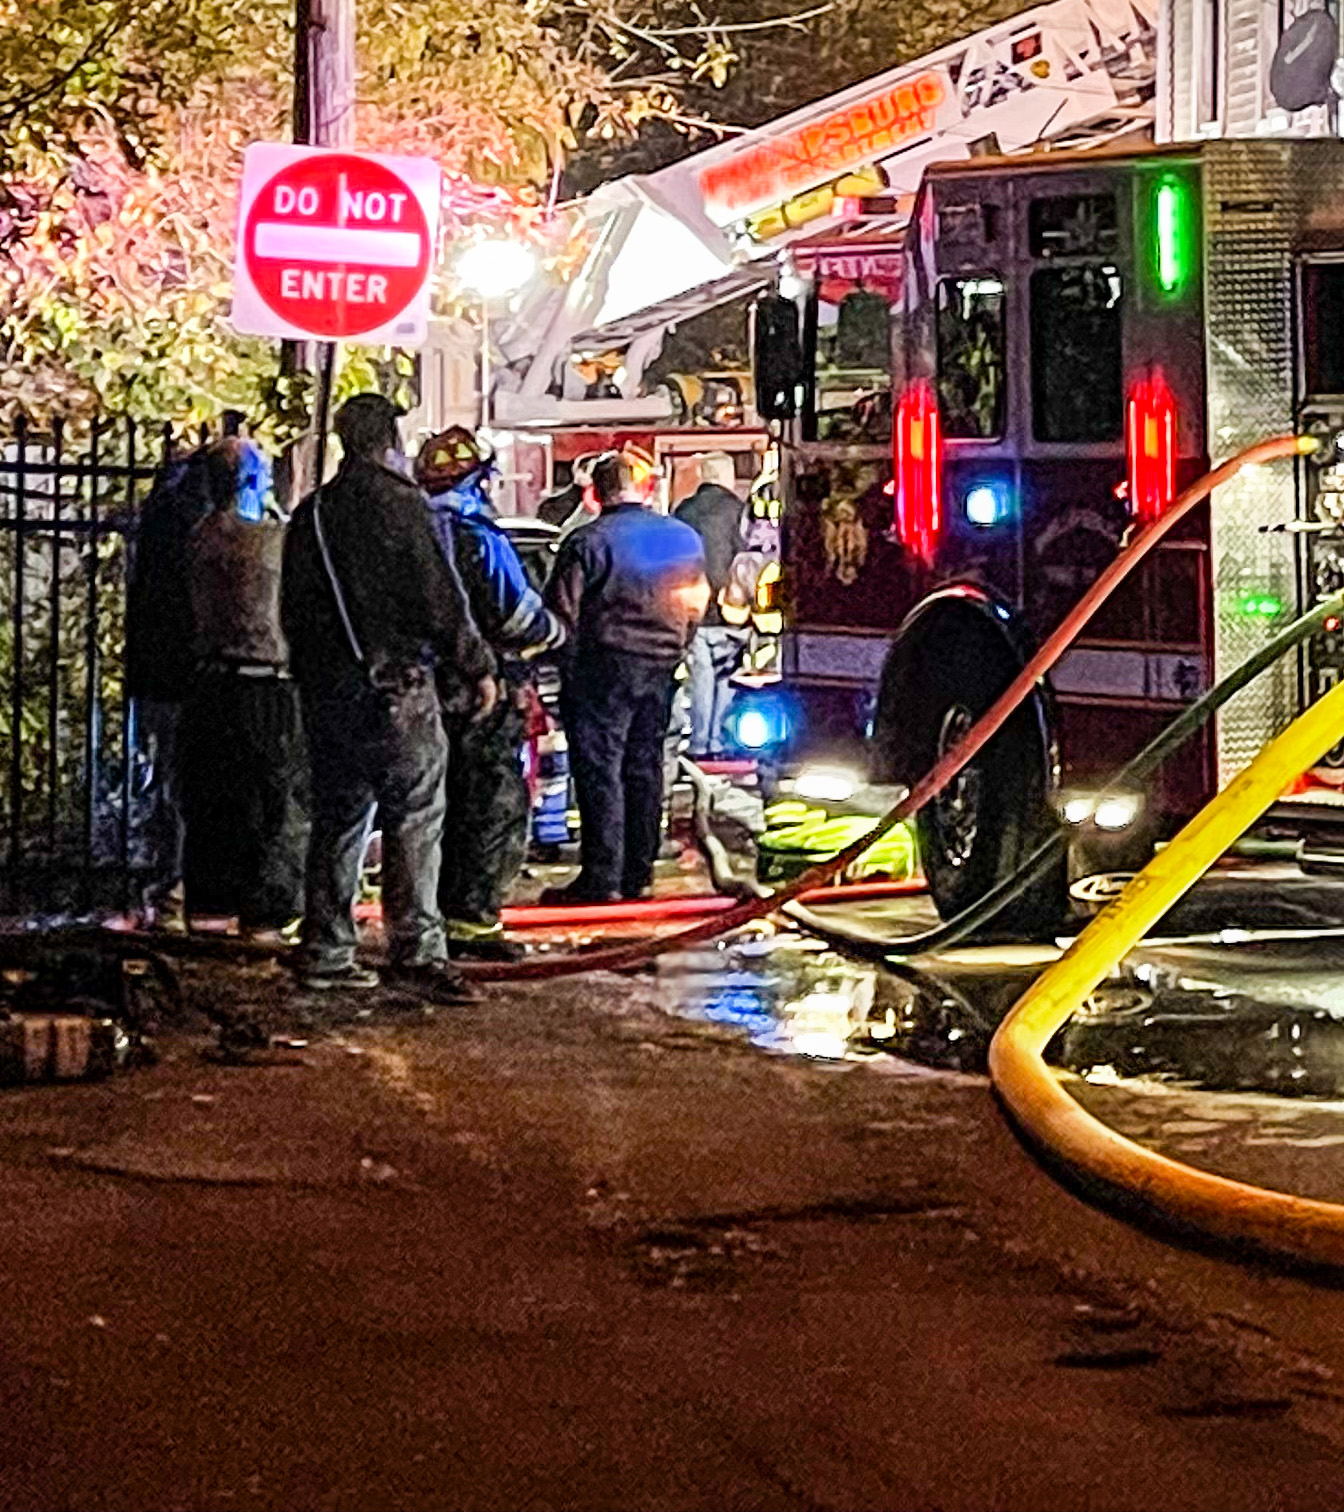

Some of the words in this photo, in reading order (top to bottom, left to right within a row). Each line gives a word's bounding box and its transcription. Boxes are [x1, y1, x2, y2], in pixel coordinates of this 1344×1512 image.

[273, 185, 320, 216] DO
[339, 192, 407, 222] NOT
[280, 268, 388, 304] ENTER
